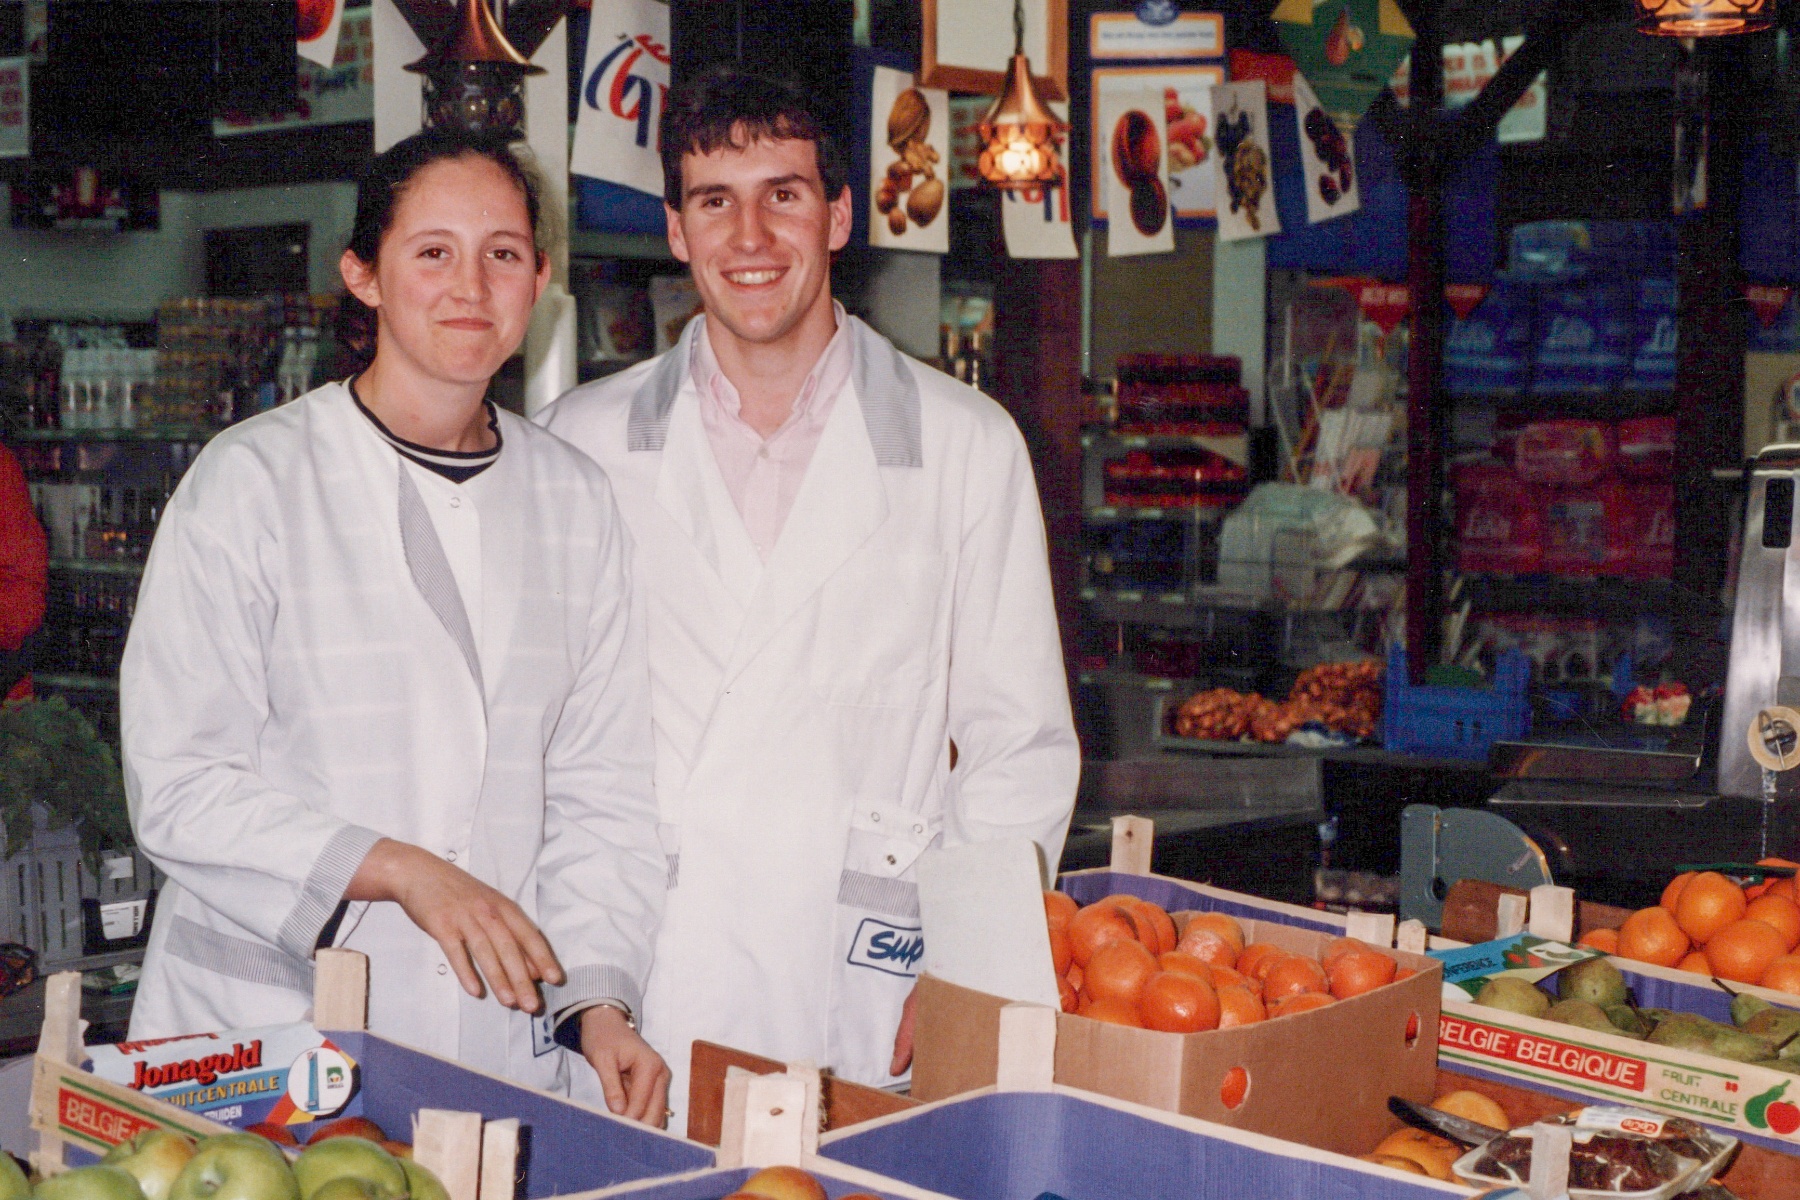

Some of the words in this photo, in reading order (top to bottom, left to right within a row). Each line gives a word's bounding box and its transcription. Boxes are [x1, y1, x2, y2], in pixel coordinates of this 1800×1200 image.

[867, 931, 924, 971] Sup
[127, 1040, 262, 1090] Jonagold
[1516, 1039, 1638, 1086] BELGIQUE
[163, 1076, 280, 1107] UITCENTRALE
[1660, 1088, 1737, 1116] CENTRALE
[65, 1097, 132, 1140] BELGIE
[203, 1105, 243, 1123] RUIDEN
